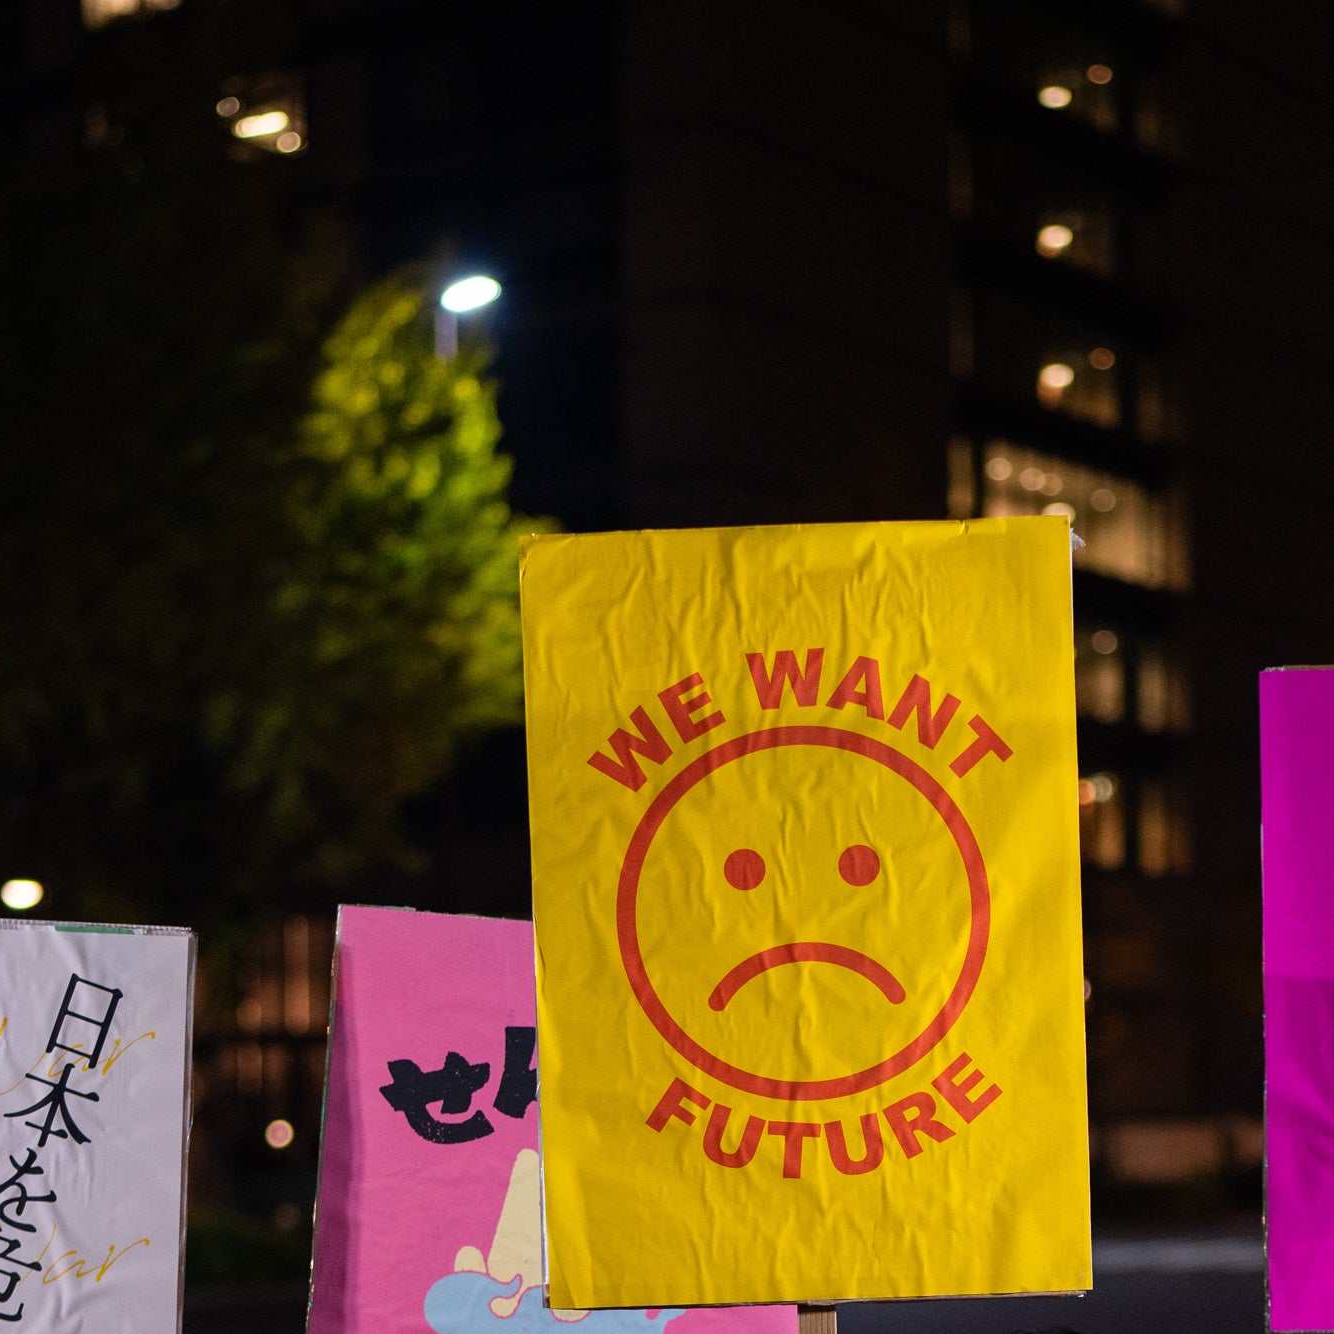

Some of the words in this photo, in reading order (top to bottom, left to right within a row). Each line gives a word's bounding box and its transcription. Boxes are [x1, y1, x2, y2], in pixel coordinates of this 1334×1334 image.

[587, 671, 727, 793] WE
[745, 647, 1014, 779] WANT
[645, 1051, 1004, 1180] FUTURE
